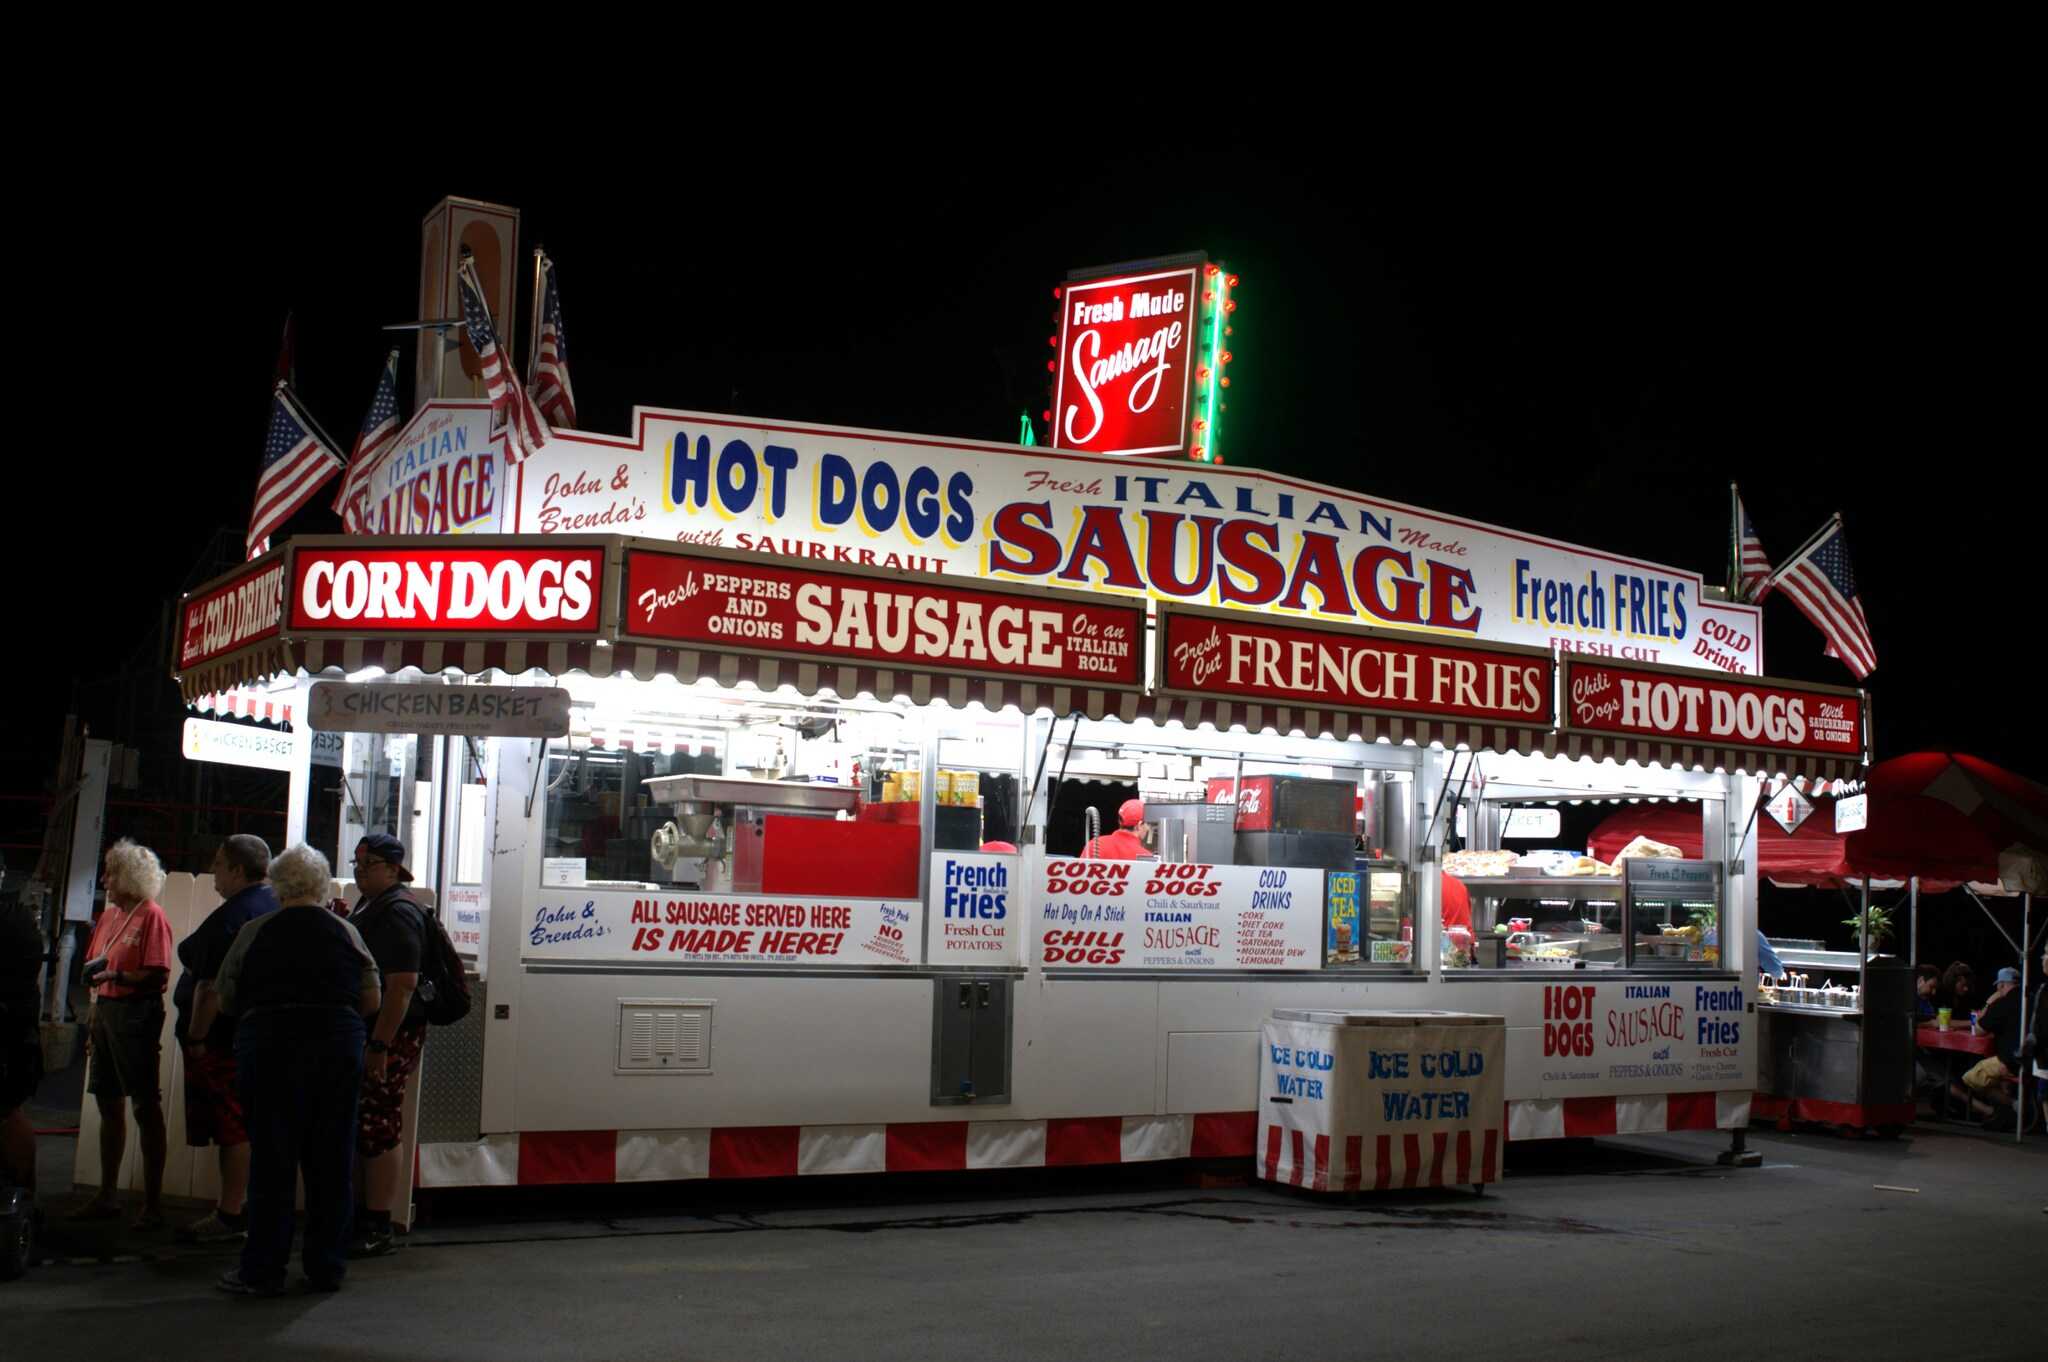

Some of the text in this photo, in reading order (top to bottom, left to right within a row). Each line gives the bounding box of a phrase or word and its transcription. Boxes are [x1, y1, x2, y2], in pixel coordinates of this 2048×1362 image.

[1073, 289, 1185, 327] Fresh Made
[1065, 320, 1182, 444] Sausage
[387, 425, 468, 489] ITALIAN
[543, 463, 631, 507] John &
[667, 431, 975, 546] HOT DOGS
[538, 499, 648, 535] Brenda's
[1023, 470, 1468, 558] Fresh ITALIAN Made
[676, 528, 948, 574] with SAURKRAUT
[985, 500, 1484, 636] SAUSAGE
[302, 558, 592, 621] CORN DOGS
[638, 570, 699, 622] Fresh
[703, 573, 792, 600] PEPPERS
[1512, 558, 1688, 642] French FRIES
[725, 597, 768, 618] AND
[203, 590, 236, 656] COLD
[708, 615, 784, 640] ONIONS
[796, 583, 1063, 669] SAUSAGE
[1072, 613, 1127, 640] On an
[1702, 618, 1752, 653] COLD
[1067, 636, 1128, 657] ITALIAN
[1174, 625, 1222, 672] Fresh
[1550, 637, 1661, 663] FRESH CUT
[1693, 638, 1748, 675] Drinks
[1078, 653, 1117, 673] ROLL
[1192, 652, 1223, 687] Cut
[1227, 633, 1542, 714] FRENCH FRIES
[1572, 673, 1612, 704] Chili
[344, 691, 544, 720] CHICKEN BASKET
[1577, 698, 1620, 724] Dogs
[1620, 678, 1806, 744] HOT DOGS
[1819, 702, 1844, 719] With
[1808, 716, 1854, 732] SAUERKRAUT
[1814, 729, 1851, 744] OR ONIONS
[945, 860, 1007, 887] French
[1047, 861, 1131, 879] CORN
[1154, 864, 1214, 880] HOT
[1259, 869, 1288, 889] COLD
[1046, 878, 1129, 896] DOGS
[1144, 880, 1222, 897] DOGS
[1332, 877, 1356, 894] ICED
[944, 886, 1007, 920] Fries
[1043, 902, 1126, 925] Hot Dog On A Stick
[1146, 898, 1168, 909] Chili
[1169, 899, 1178, 909] &
[1252, 890, 1293, 910] DRINKS
[1331, 896, 1357, 917] TEA
[534, 900, 595, 930] John &
[631, 900, 852, 930] ALL SAUSAGE SERVED HERE
[1144, 911, 1192, 923] ITALIAN
[1242, 911, 1264, 920] COKE
[1242, 920, 1284, 930] DIET COKE
[530, 918, 606, 946] Brenda's
[632, 928, 843, 955] IS MADE HERE!
[879, 924, 903, 941] NO
[944, 923, 1005, 938] Fresh Cut
[1043, 930, 1124, 947] CHILI
[1143, 924, 1221, 950] SAUSAGE
[1240, 938, 1284, 947] GATORADE
[1241, 929, 1273, 938] ICE TEA
[946, 939, 1002, 951] POTATOES
[1043, 947, 1125, 965] DOGS
[1240, 947, 1305, 957] MOUNTAIN DEW
[1143, 956, 1215, 966] PEPPERS & ONIONS
[1240, 956, 1285, 965] LEMONADE
[1543, 985, 1596, 1020] HOT
[1625, 985, 1671, 999] ITALIAN
[1695, 985, 1743, 1012] French
[1605, 1002, 1685, 1048] SAUSAGE
[1697, 1016, 1740, 1046] Fries
[1543, 1022, 1594, 1057] DOGS
[1700, 1047, 1738, 1058] Fresh Cut
[1270, 1044, 1335, 1072] ICE COLD
[1368, 1048, 1485, 1080] ICE COLD
[1609, 1064, 1643, 1079] PEPPERS
[1651, 1063, 1683, 1078] ONIONS
[1276, 1073, 1323, 1100] WATER
[1382, 1090, 1471, 1122] WATER
